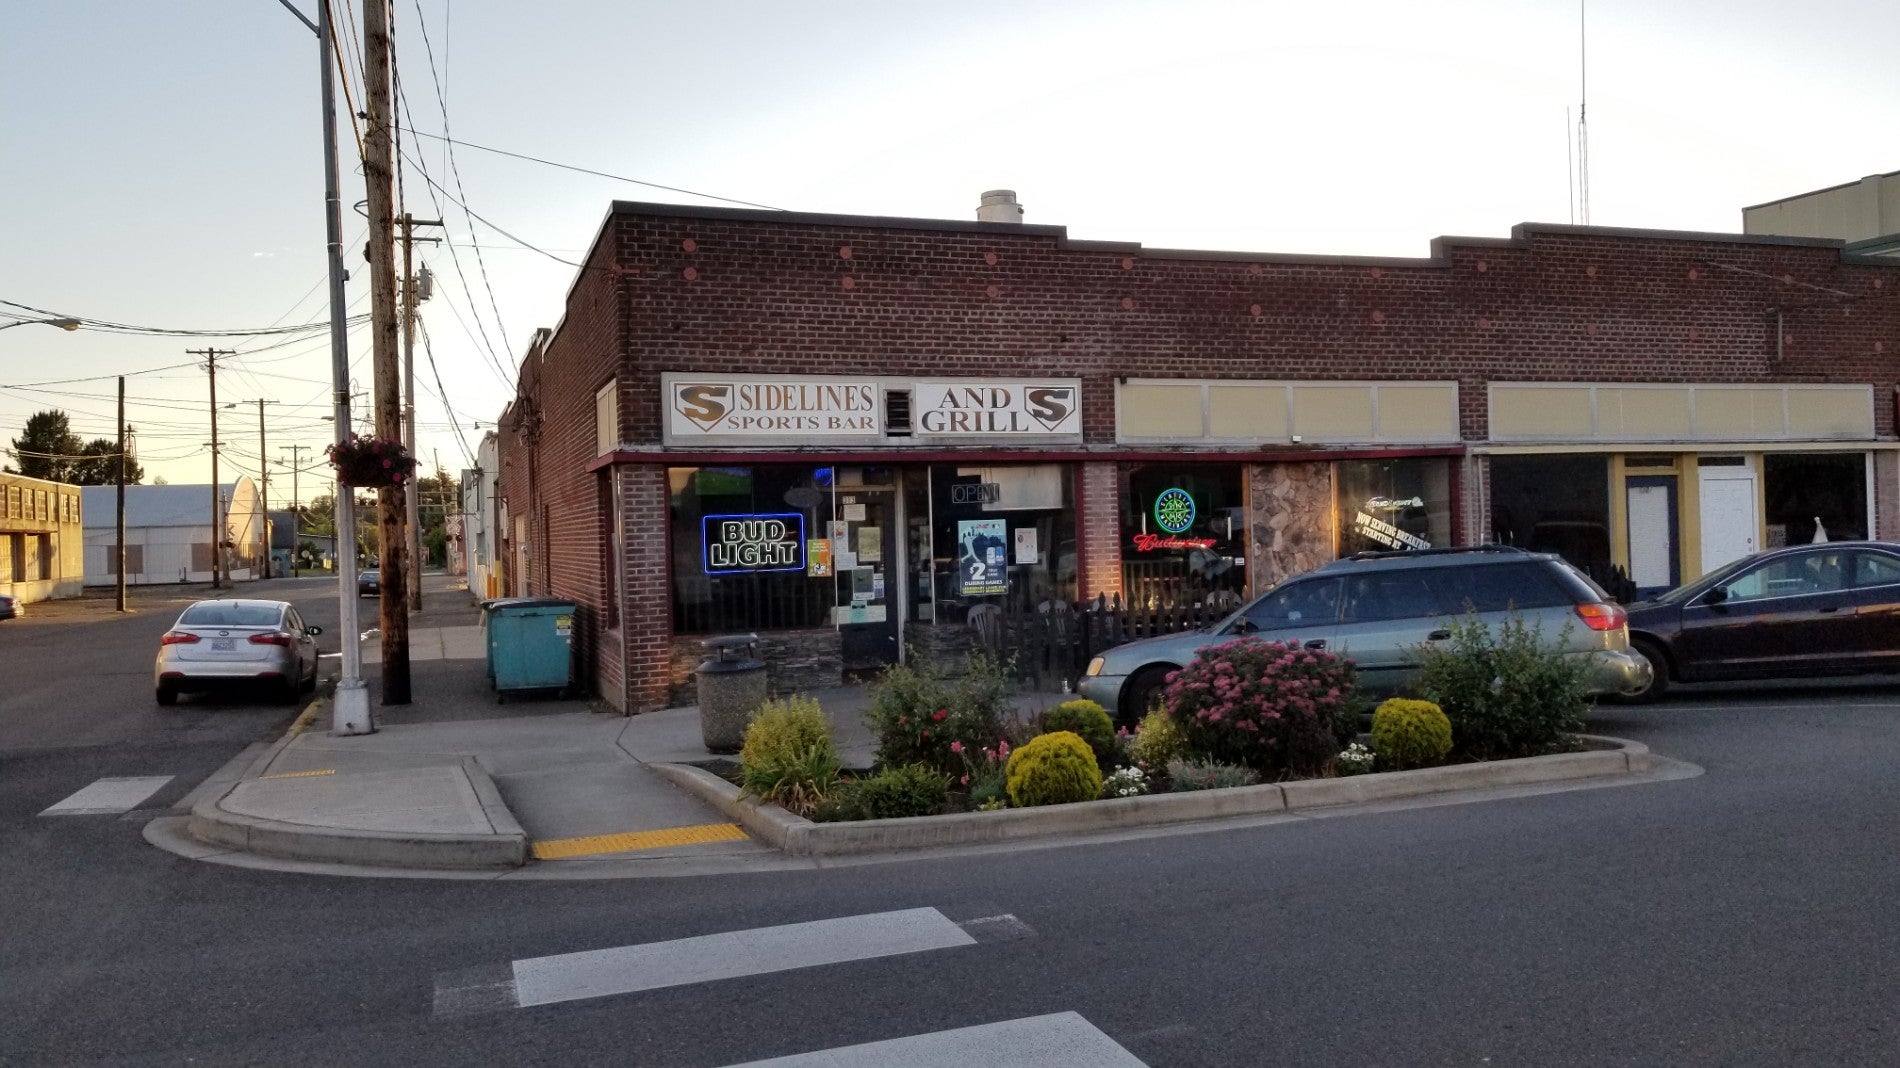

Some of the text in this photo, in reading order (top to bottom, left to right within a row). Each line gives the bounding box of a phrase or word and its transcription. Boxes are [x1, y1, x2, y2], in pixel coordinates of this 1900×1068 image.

[740, 383, 873, 412] SIDELINES
[938, 387, 1011, 409] AND
[728, 415, 875, 429] SPORTS BAR
[922, 410, 1029, 432] GRILL
[954, 485, 999, 502] OPEN
[723, 520, 785, 544] BUD
[1355, 511, 1432, 550] NOW SERVING BREAKFAST
[1362, 526, 1393, 546] STARTING
[711, 542, 797, 566] LIGHT
[1133, 534, 1217, 552] Budweiser
